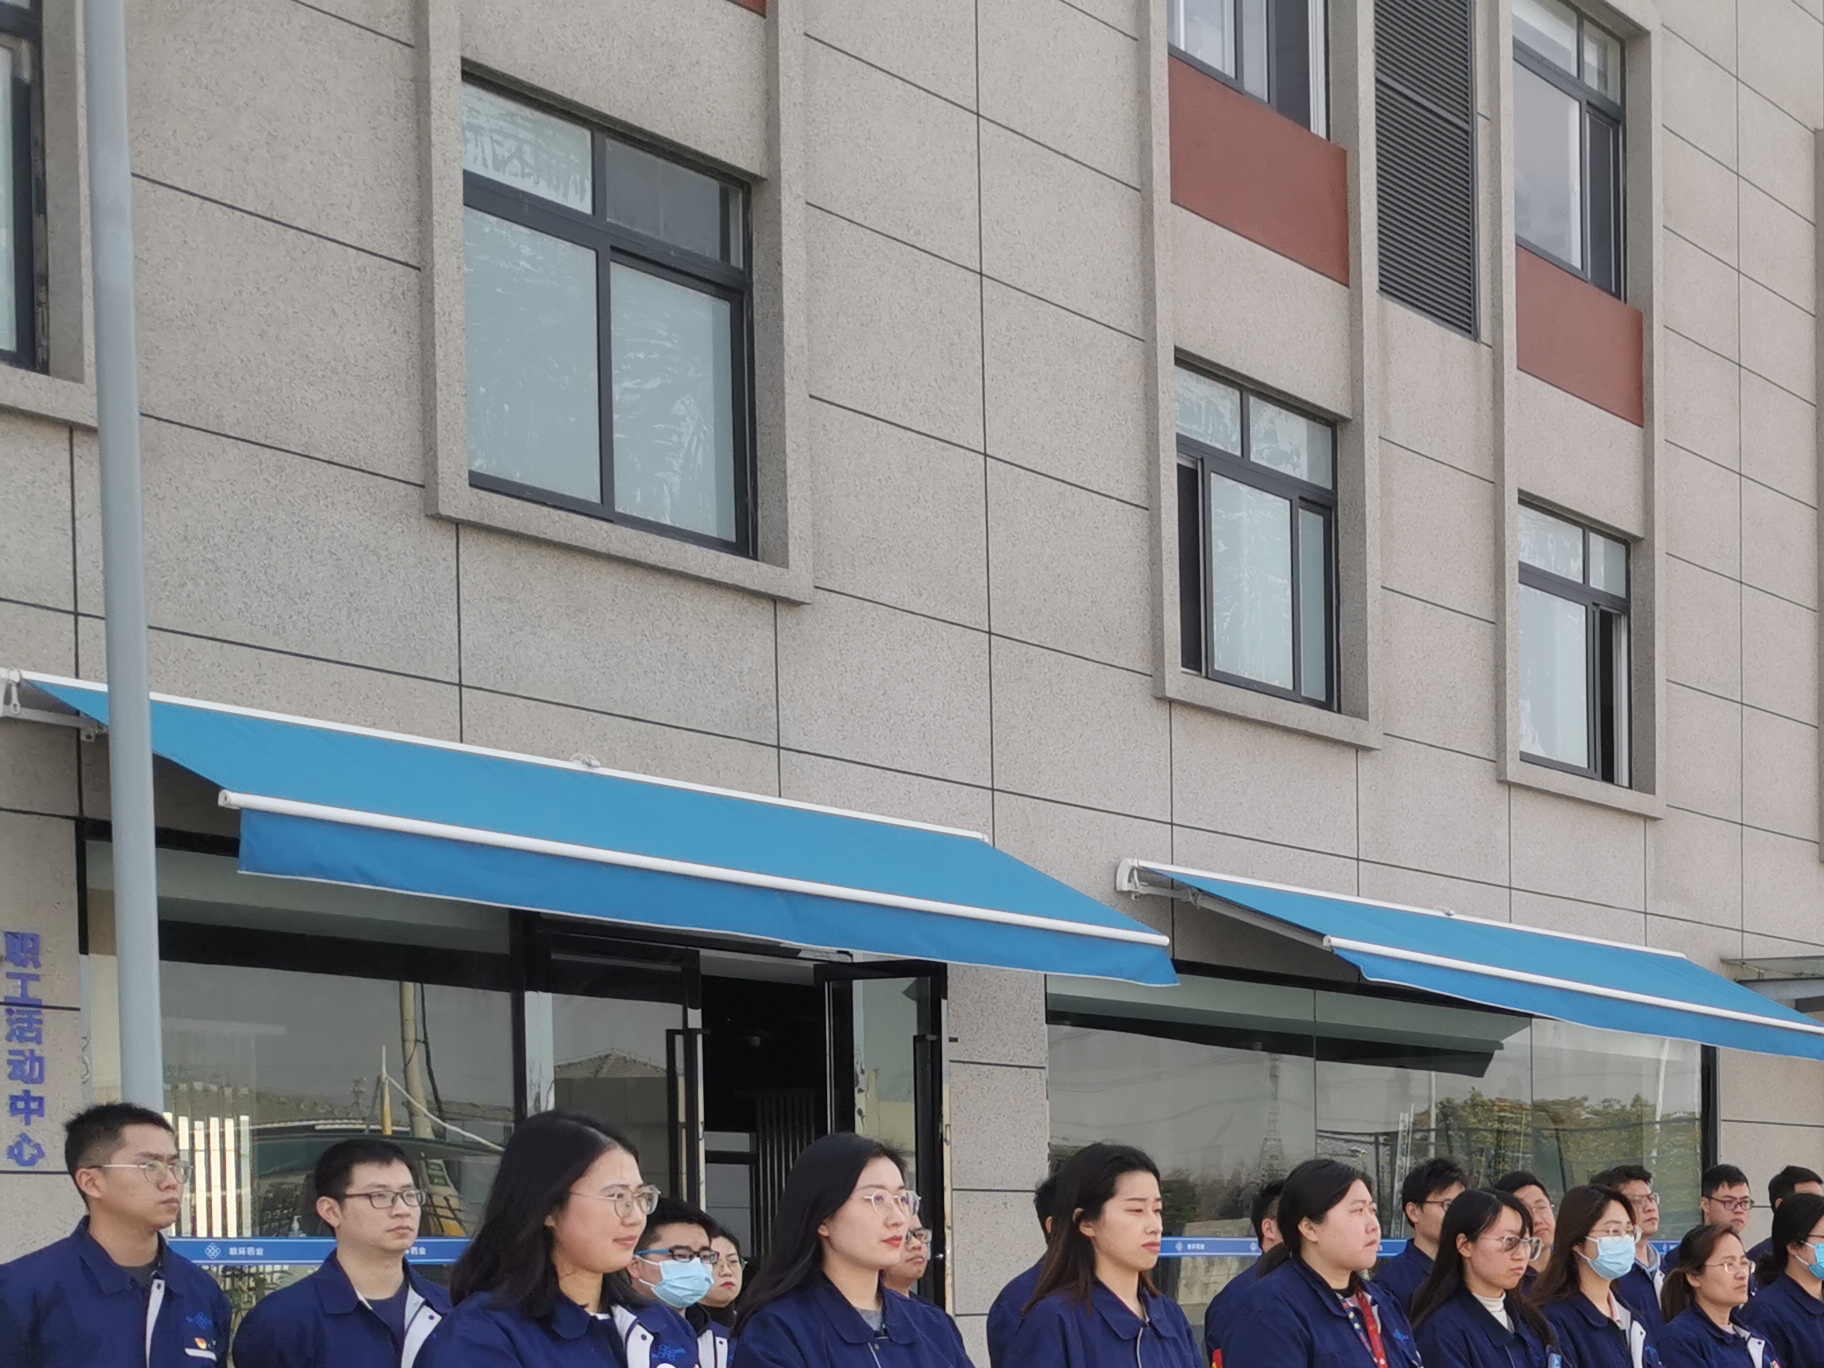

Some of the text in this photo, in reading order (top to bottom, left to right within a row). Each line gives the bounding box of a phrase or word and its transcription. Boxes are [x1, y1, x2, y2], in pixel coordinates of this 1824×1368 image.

[4, 931, 46, 1167] 职工活动中心
